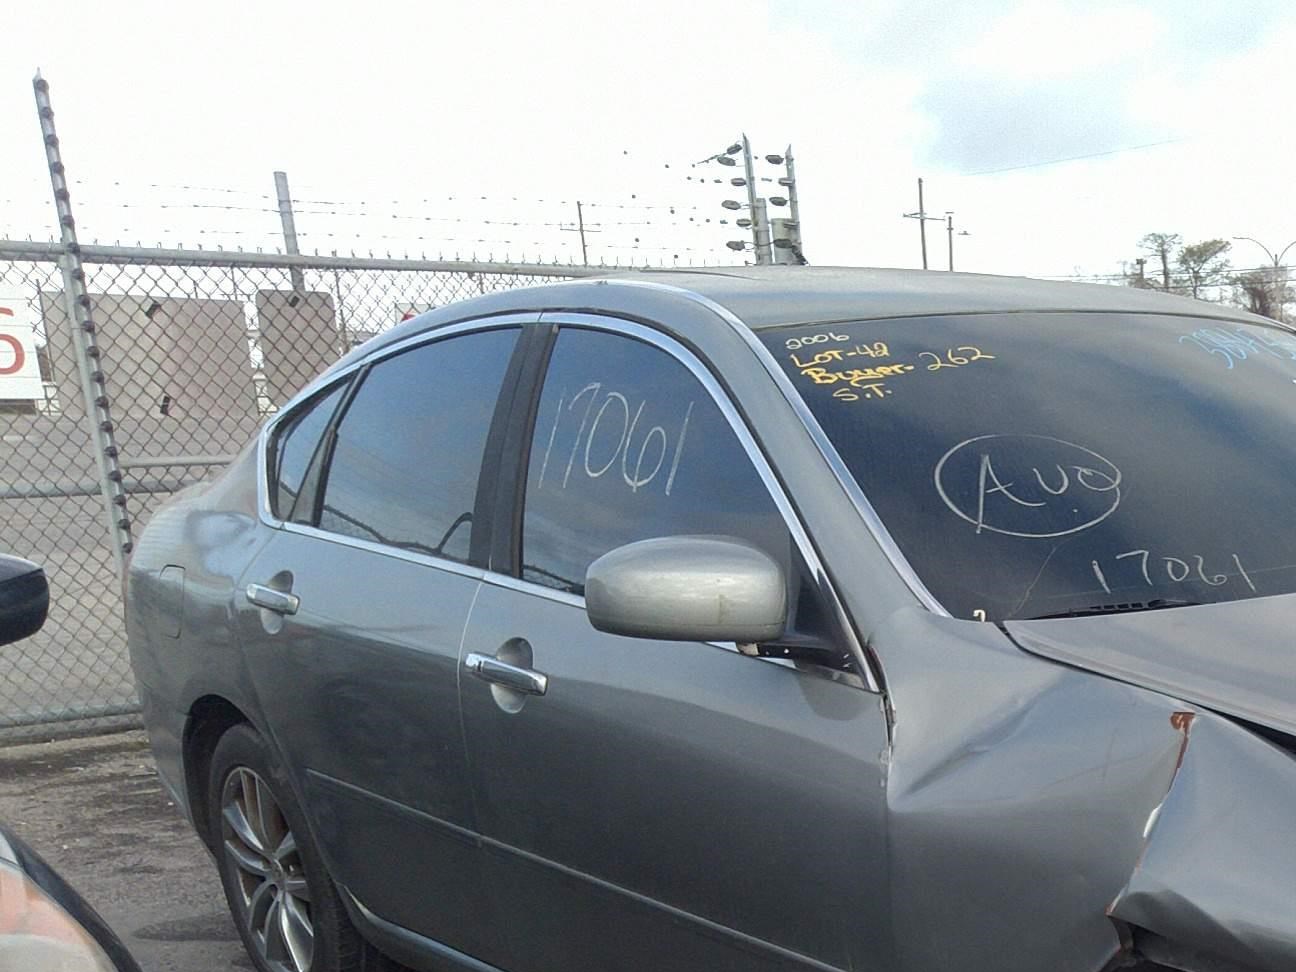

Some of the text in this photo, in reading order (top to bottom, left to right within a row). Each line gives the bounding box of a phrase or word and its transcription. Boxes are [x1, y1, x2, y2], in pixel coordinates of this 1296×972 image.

[785, 332, 849, 350] 2006
[918, 346, 996, 371] 262
[538, 382, 694, 496] 17061
[1091, 550, 1256, 594] 17061
